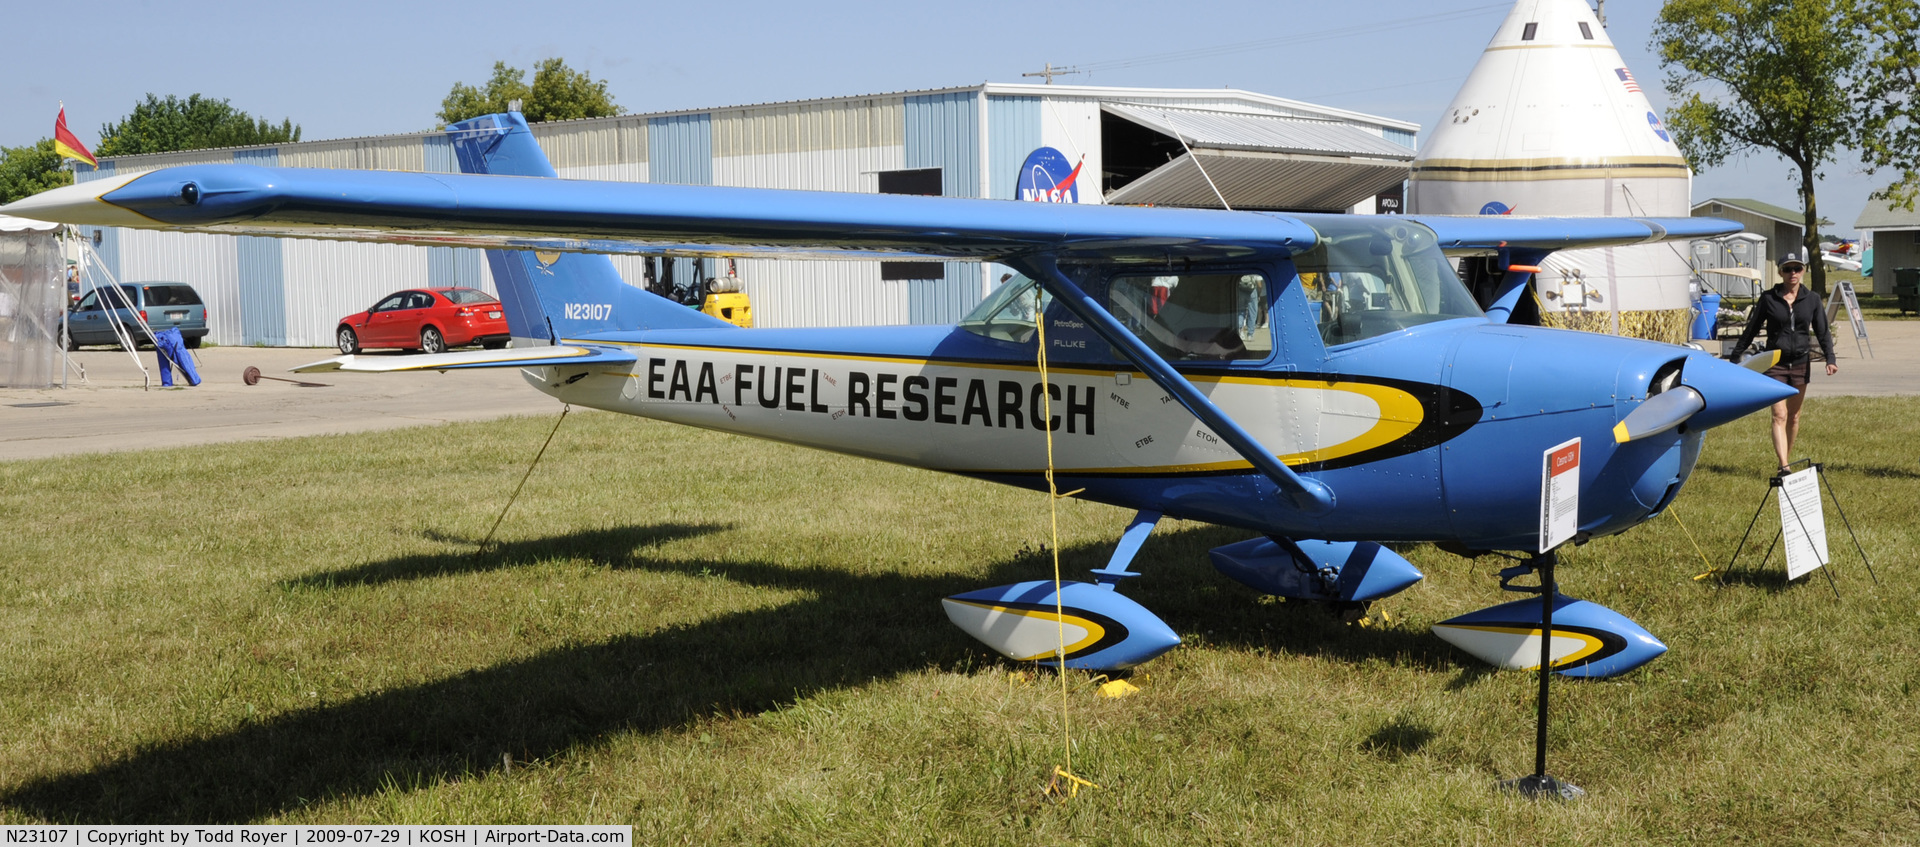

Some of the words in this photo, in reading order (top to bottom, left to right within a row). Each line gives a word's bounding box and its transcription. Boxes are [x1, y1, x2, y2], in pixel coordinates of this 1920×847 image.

[1022, 188, 1073, 204] NASA
[565, 303, 612, 320] N23107
[1053, 319, 1085, 329] PetroSpec
[1053, 339, 1086, 349] FLUKE
[719, 372, 733, 385] ETBE
[822, 371, 838, 387] TAME
[648, 357, 720, 405] EAA
[734, 363, 829, 414] FUEL
[848, 371, 1096, 436] RESEARCH
[1110, 392, 1130, 410] MTBE
[1160, 393, 1177, 405] TAM
[722, 404, 737, 422] MTBE
[831, 408, 846, 421] ETOH
[1135, 435, 1154, 449] ETBE
[1196, 430, 1218, 445] ETOH
